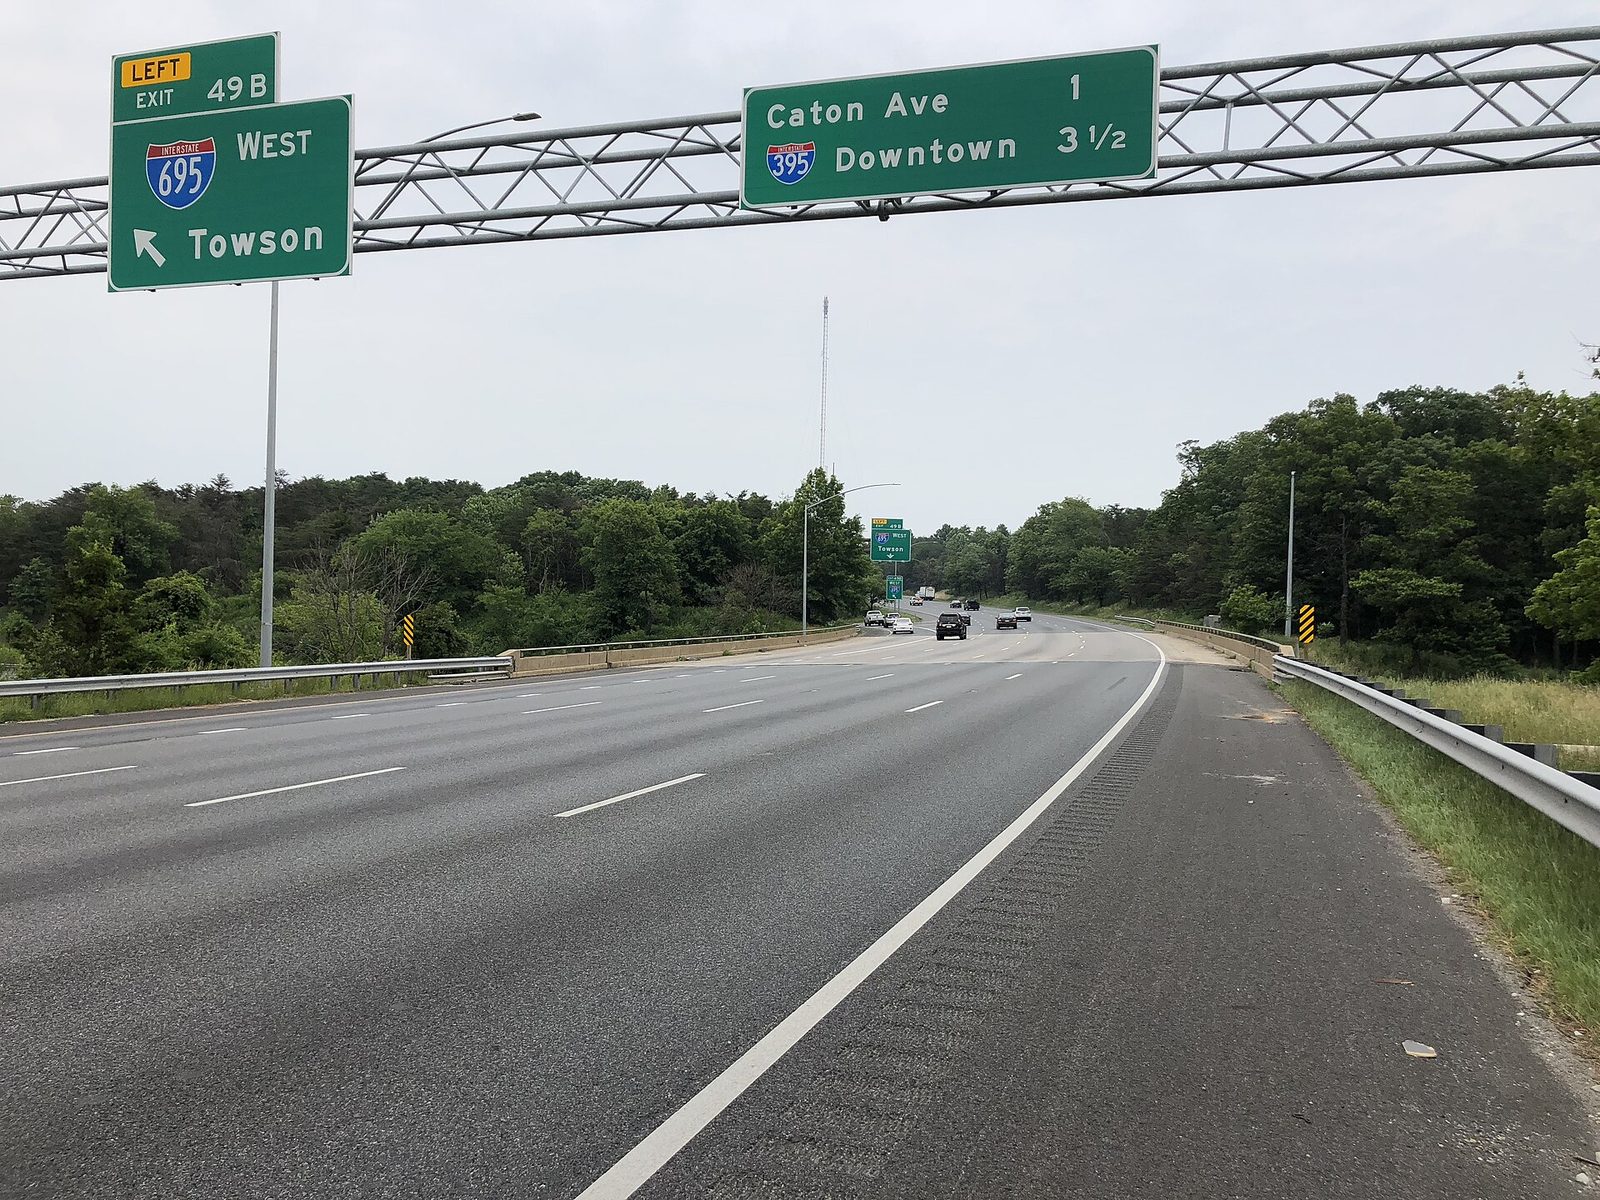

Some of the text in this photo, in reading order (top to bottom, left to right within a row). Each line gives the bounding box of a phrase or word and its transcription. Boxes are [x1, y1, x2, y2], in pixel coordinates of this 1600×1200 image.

[132, 58, 181, 82] LEFT
[136, 88, 174, 109] EXIT
[766, 74, 1080, 130] Caton Ave 1
[158, 130, 312, 197] 695 WEST
[161, 143, 200, 156] INTERSTATE
[772, 151, 809, 177] 395
[835, 134, 1017, 173] Downtown
[1057, 126, 1078, 154] 3
[188, 225, 323, 260] Towson
